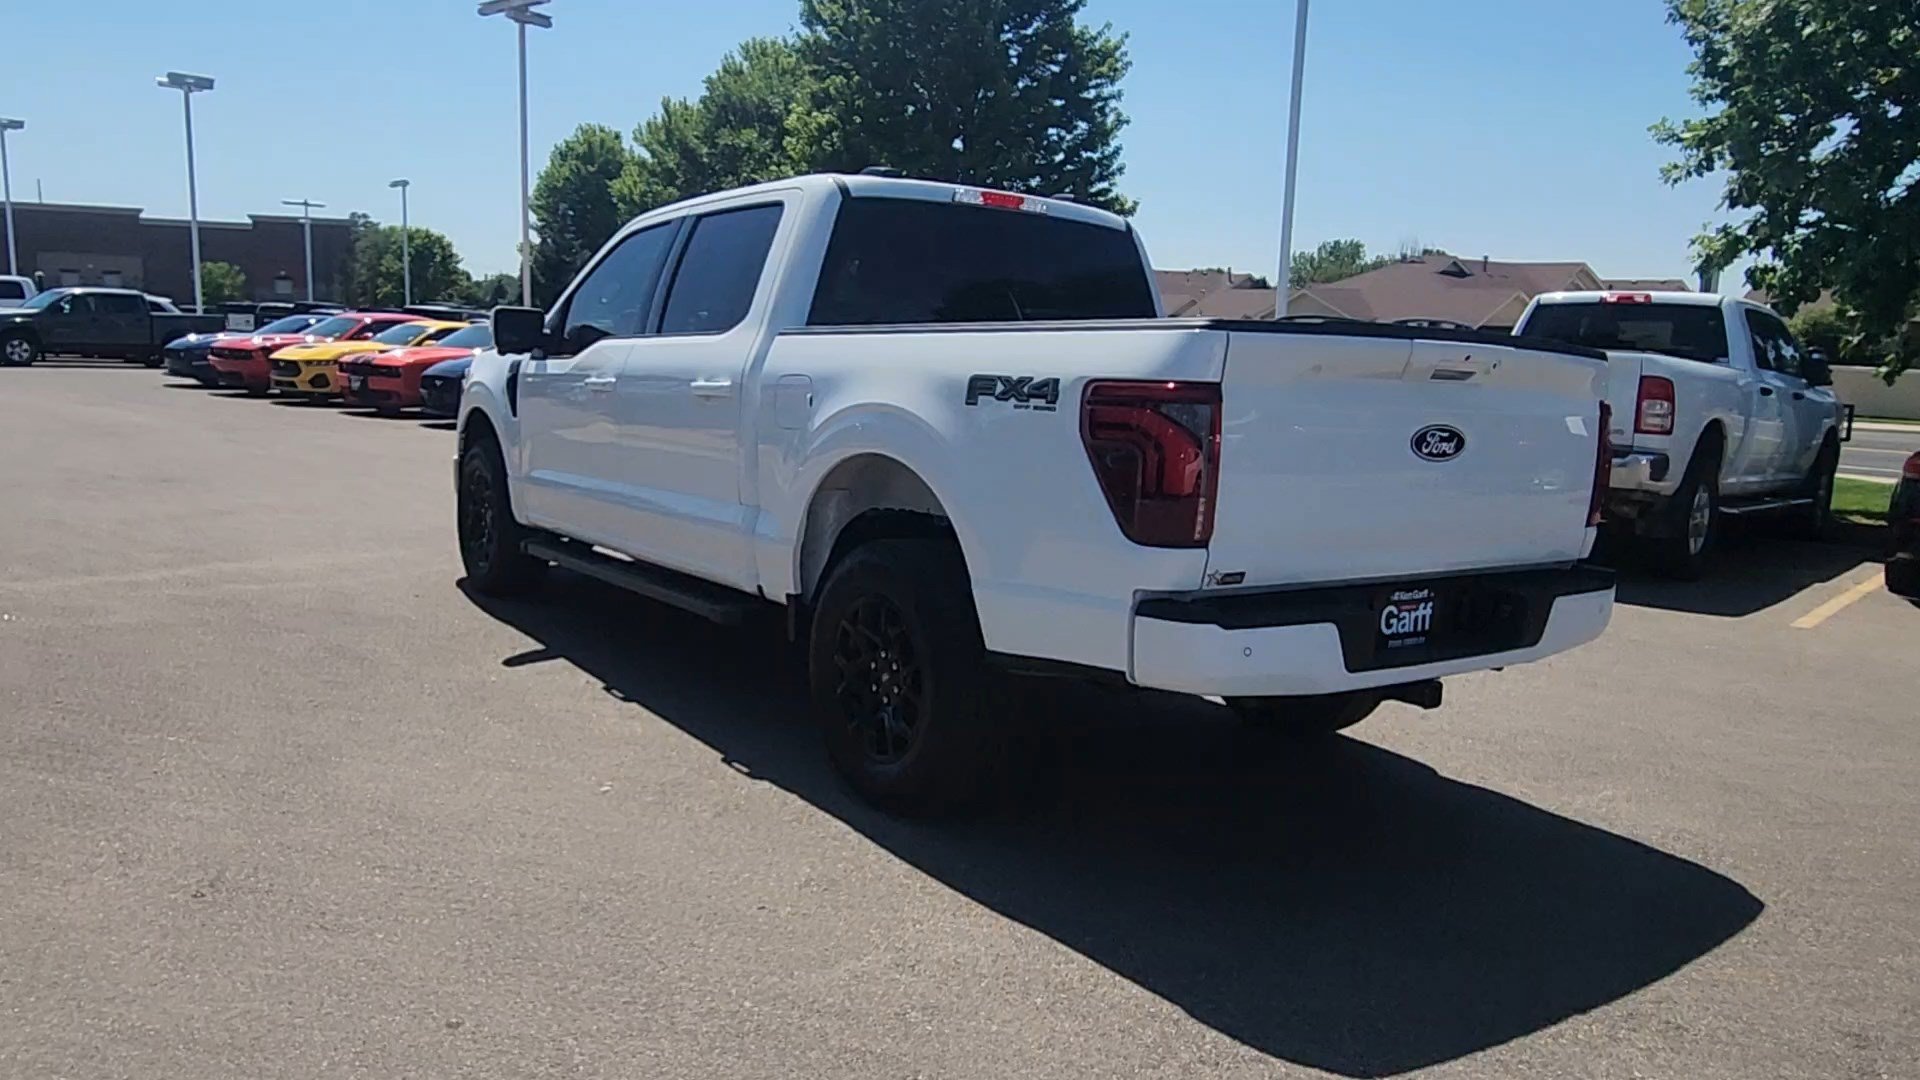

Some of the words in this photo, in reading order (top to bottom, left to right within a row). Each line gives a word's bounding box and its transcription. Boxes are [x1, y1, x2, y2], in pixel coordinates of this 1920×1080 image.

[965, 374, 1060, 405] FX4
[1422, 430, 1458, 454] Ford
[1380, 601, 1433, 635] Garff
